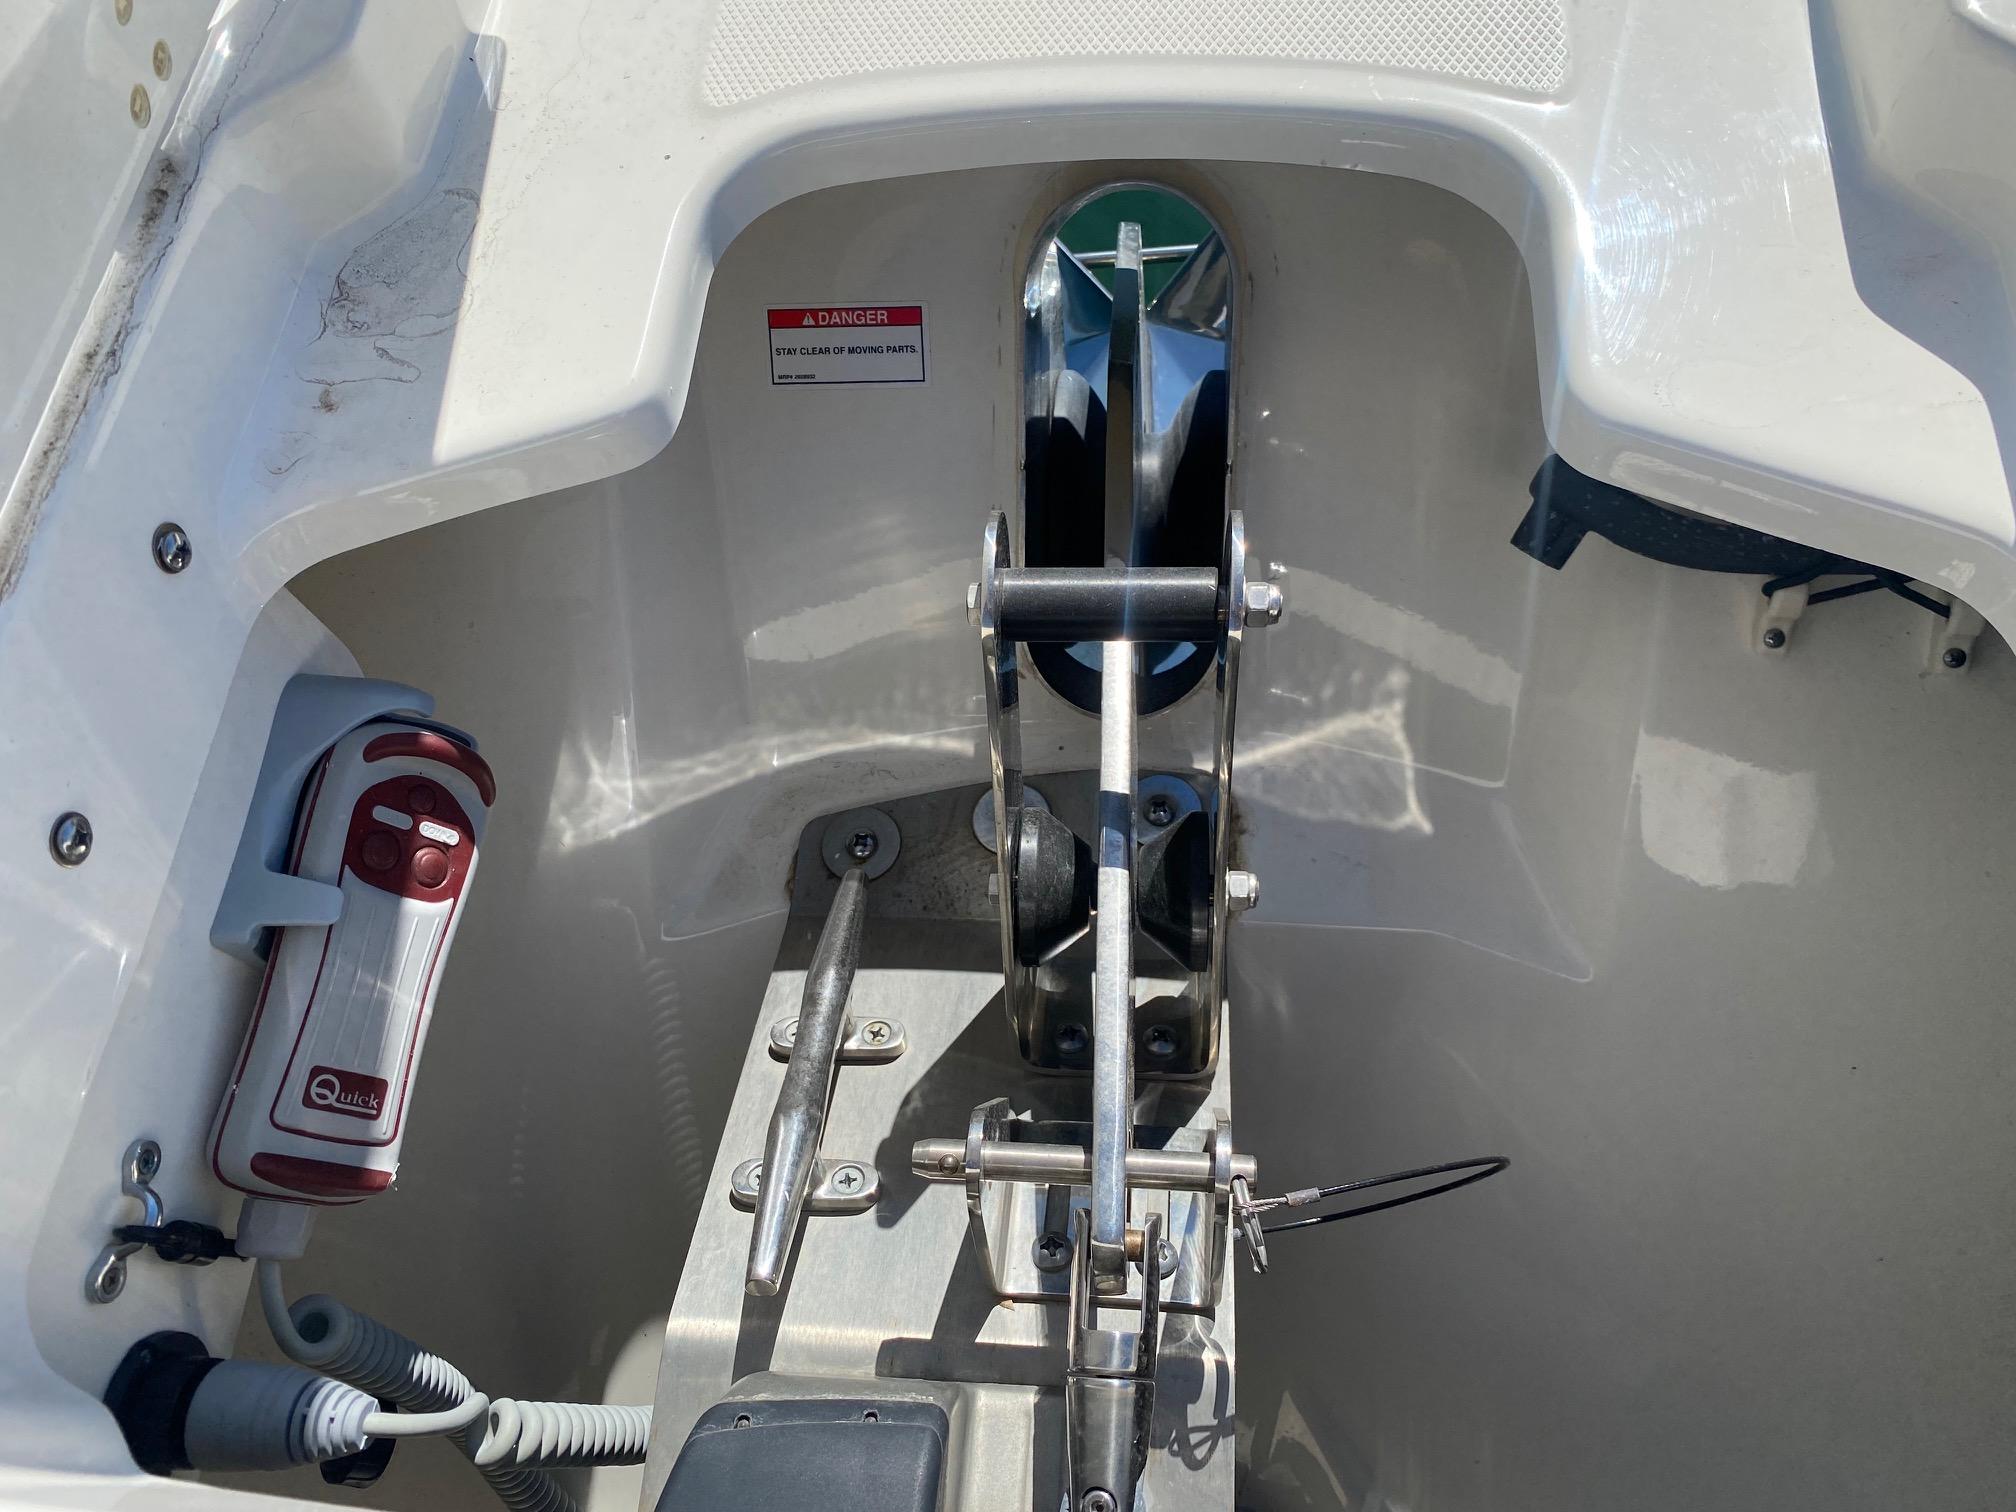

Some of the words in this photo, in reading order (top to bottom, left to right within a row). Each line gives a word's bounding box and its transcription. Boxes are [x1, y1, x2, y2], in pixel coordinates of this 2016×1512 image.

[819, 310, 888, 325] DANGER
[775, 347, 797, 356] STAY
[800, 346, 831, 355] CLEAR
[833, 346, 845, 355] OF
[848, 345, 883, 354] MOVING
[886, 345, 918, 354] PARTS.
[310, 1074, 379, 1115] Quick
